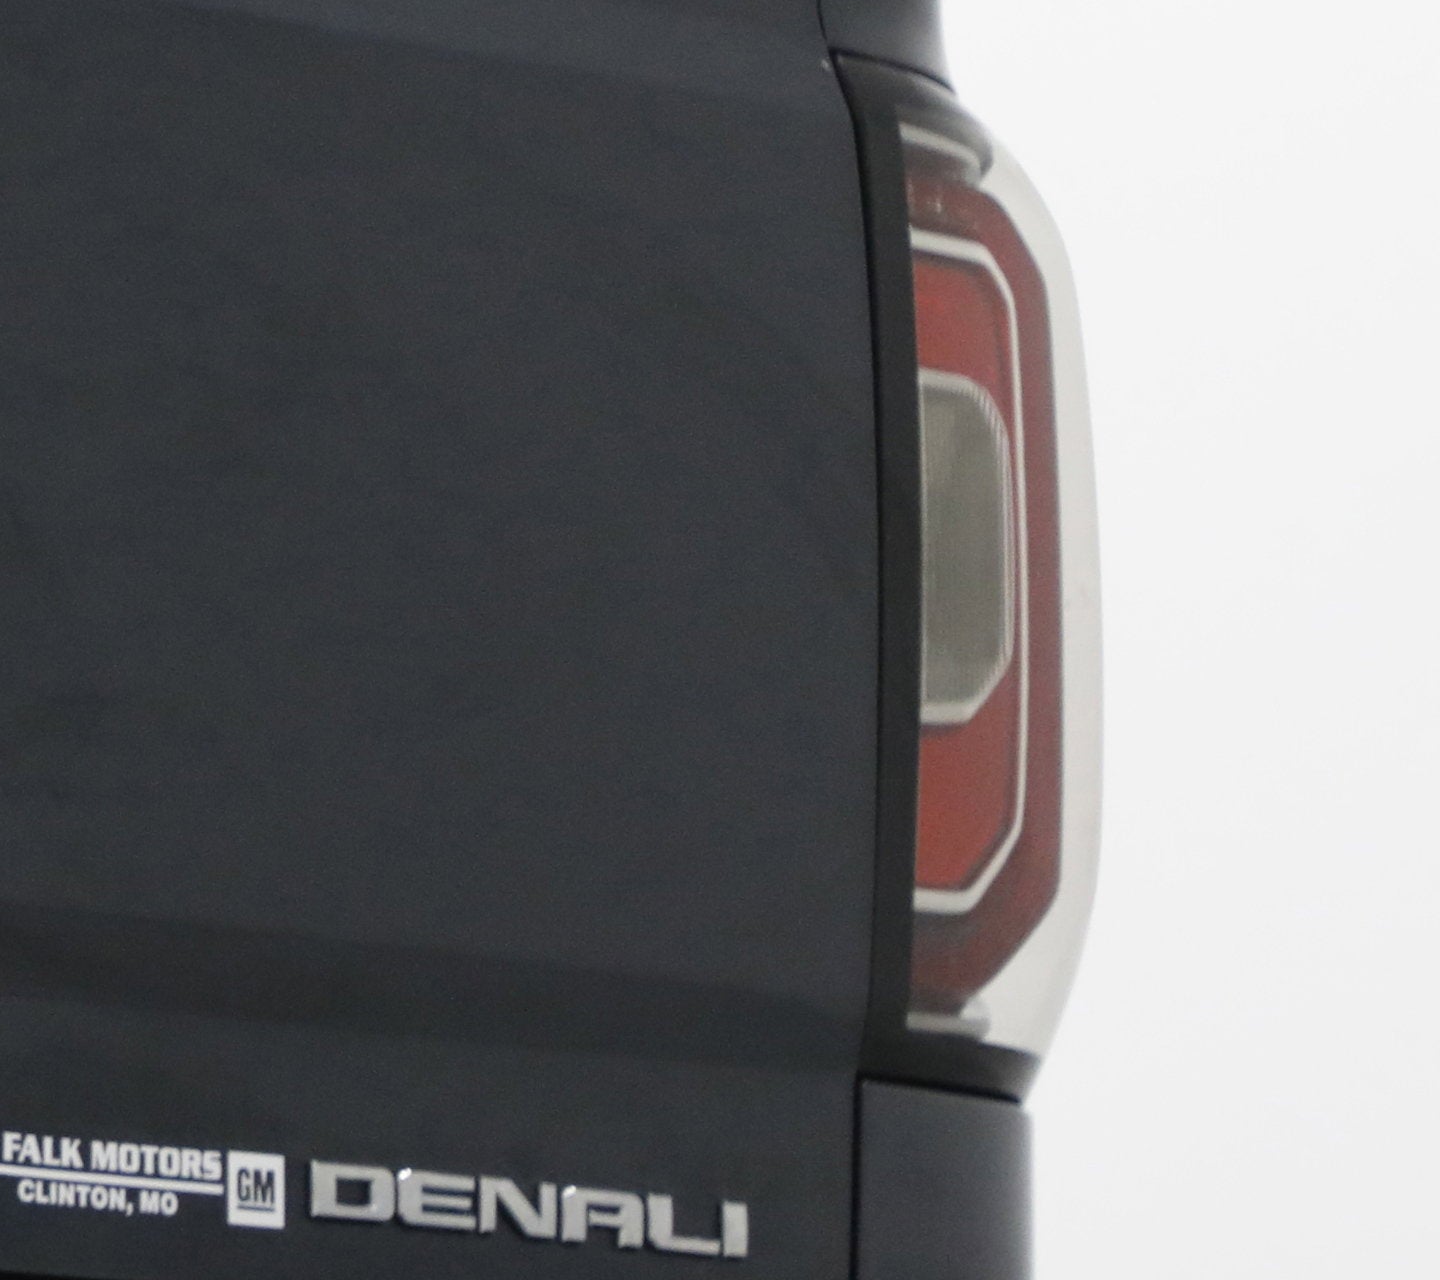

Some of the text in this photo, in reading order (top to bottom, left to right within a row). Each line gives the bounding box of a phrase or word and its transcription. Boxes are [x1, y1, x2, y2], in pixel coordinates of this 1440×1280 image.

[2, 1131, 84, 1168] FALK
[90, 1140, 223, 1180] MOTORS
[17, 1179, 178, 1217] CLINTON, MO
[237, 1167, 275, 1205] GM
[309, 1160, 749, 1258] DENALI
